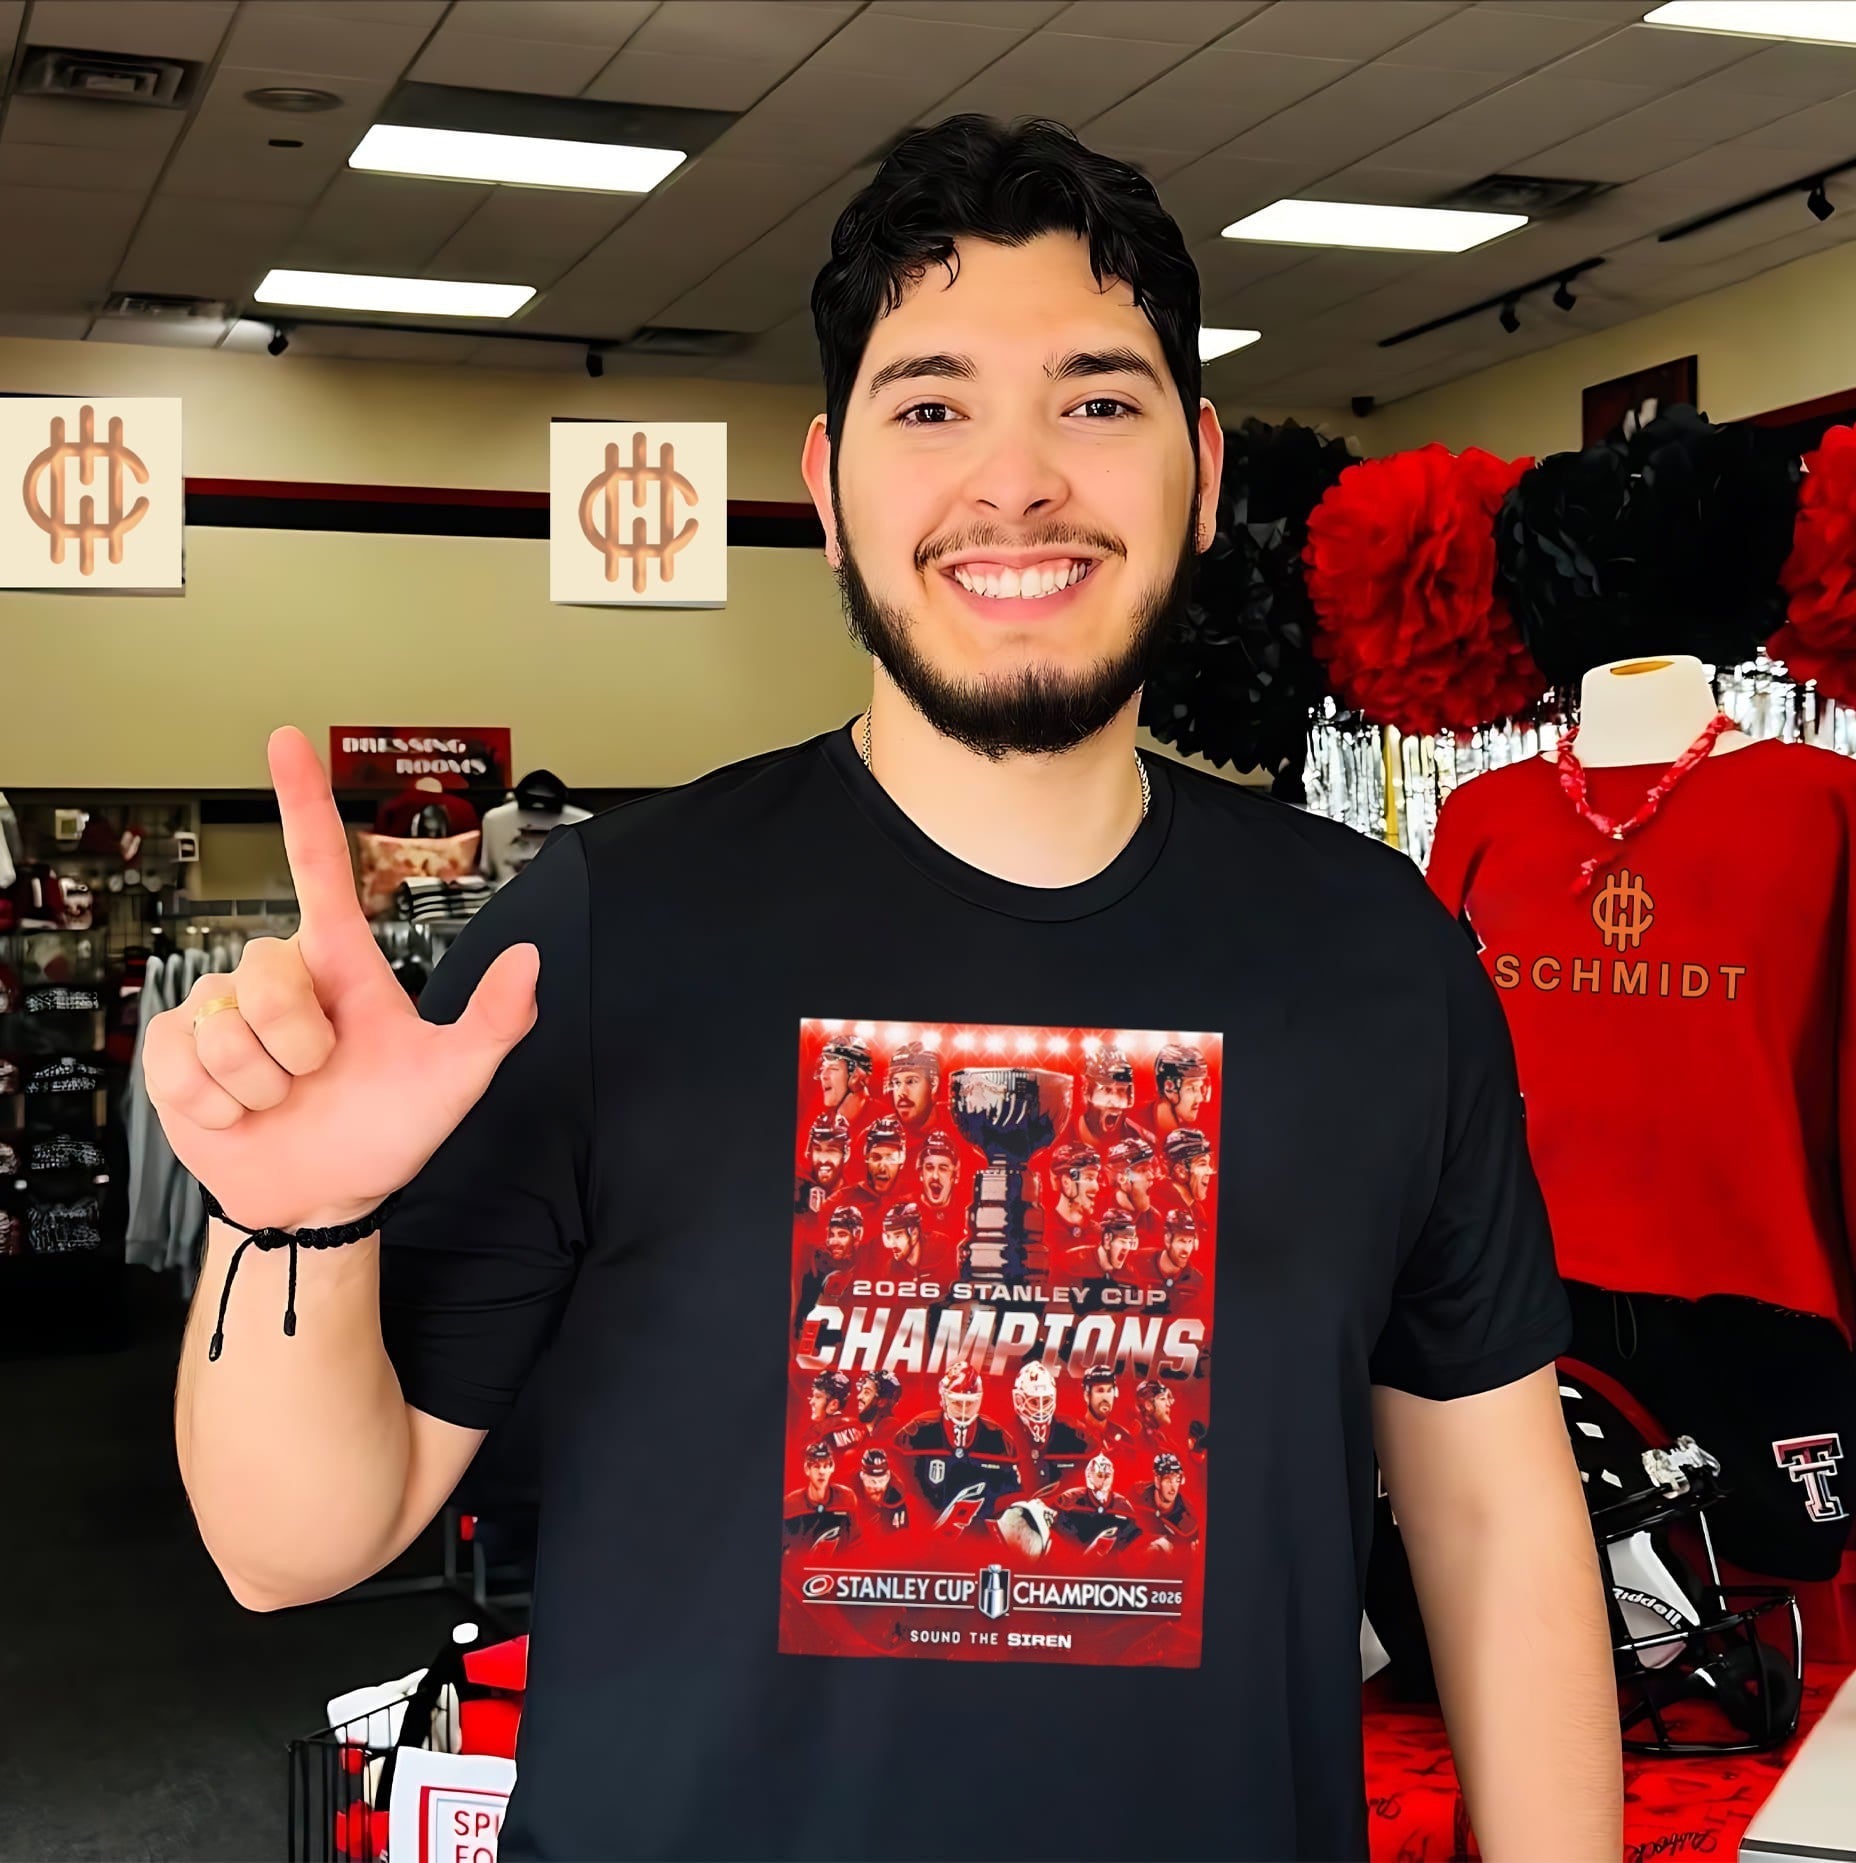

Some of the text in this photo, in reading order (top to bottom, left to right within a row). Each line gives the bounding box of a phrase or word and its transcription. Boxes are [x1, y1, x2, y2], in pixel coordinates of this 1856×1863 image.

[396, 759, 487, 775] ROOMS
[1494, 954, 1747, 1000] SCHMIDT
[853, 1279, 1167, 1306] 2026 STANLEY CUP
[796, 1304, 1205, 1380] CHAMPIONS
[836, 1576, 1182, 1609] STANLEY CUP CHAMPIONS 2026
[910, 1630, 1072, 1649] SOUND THE SIREN
